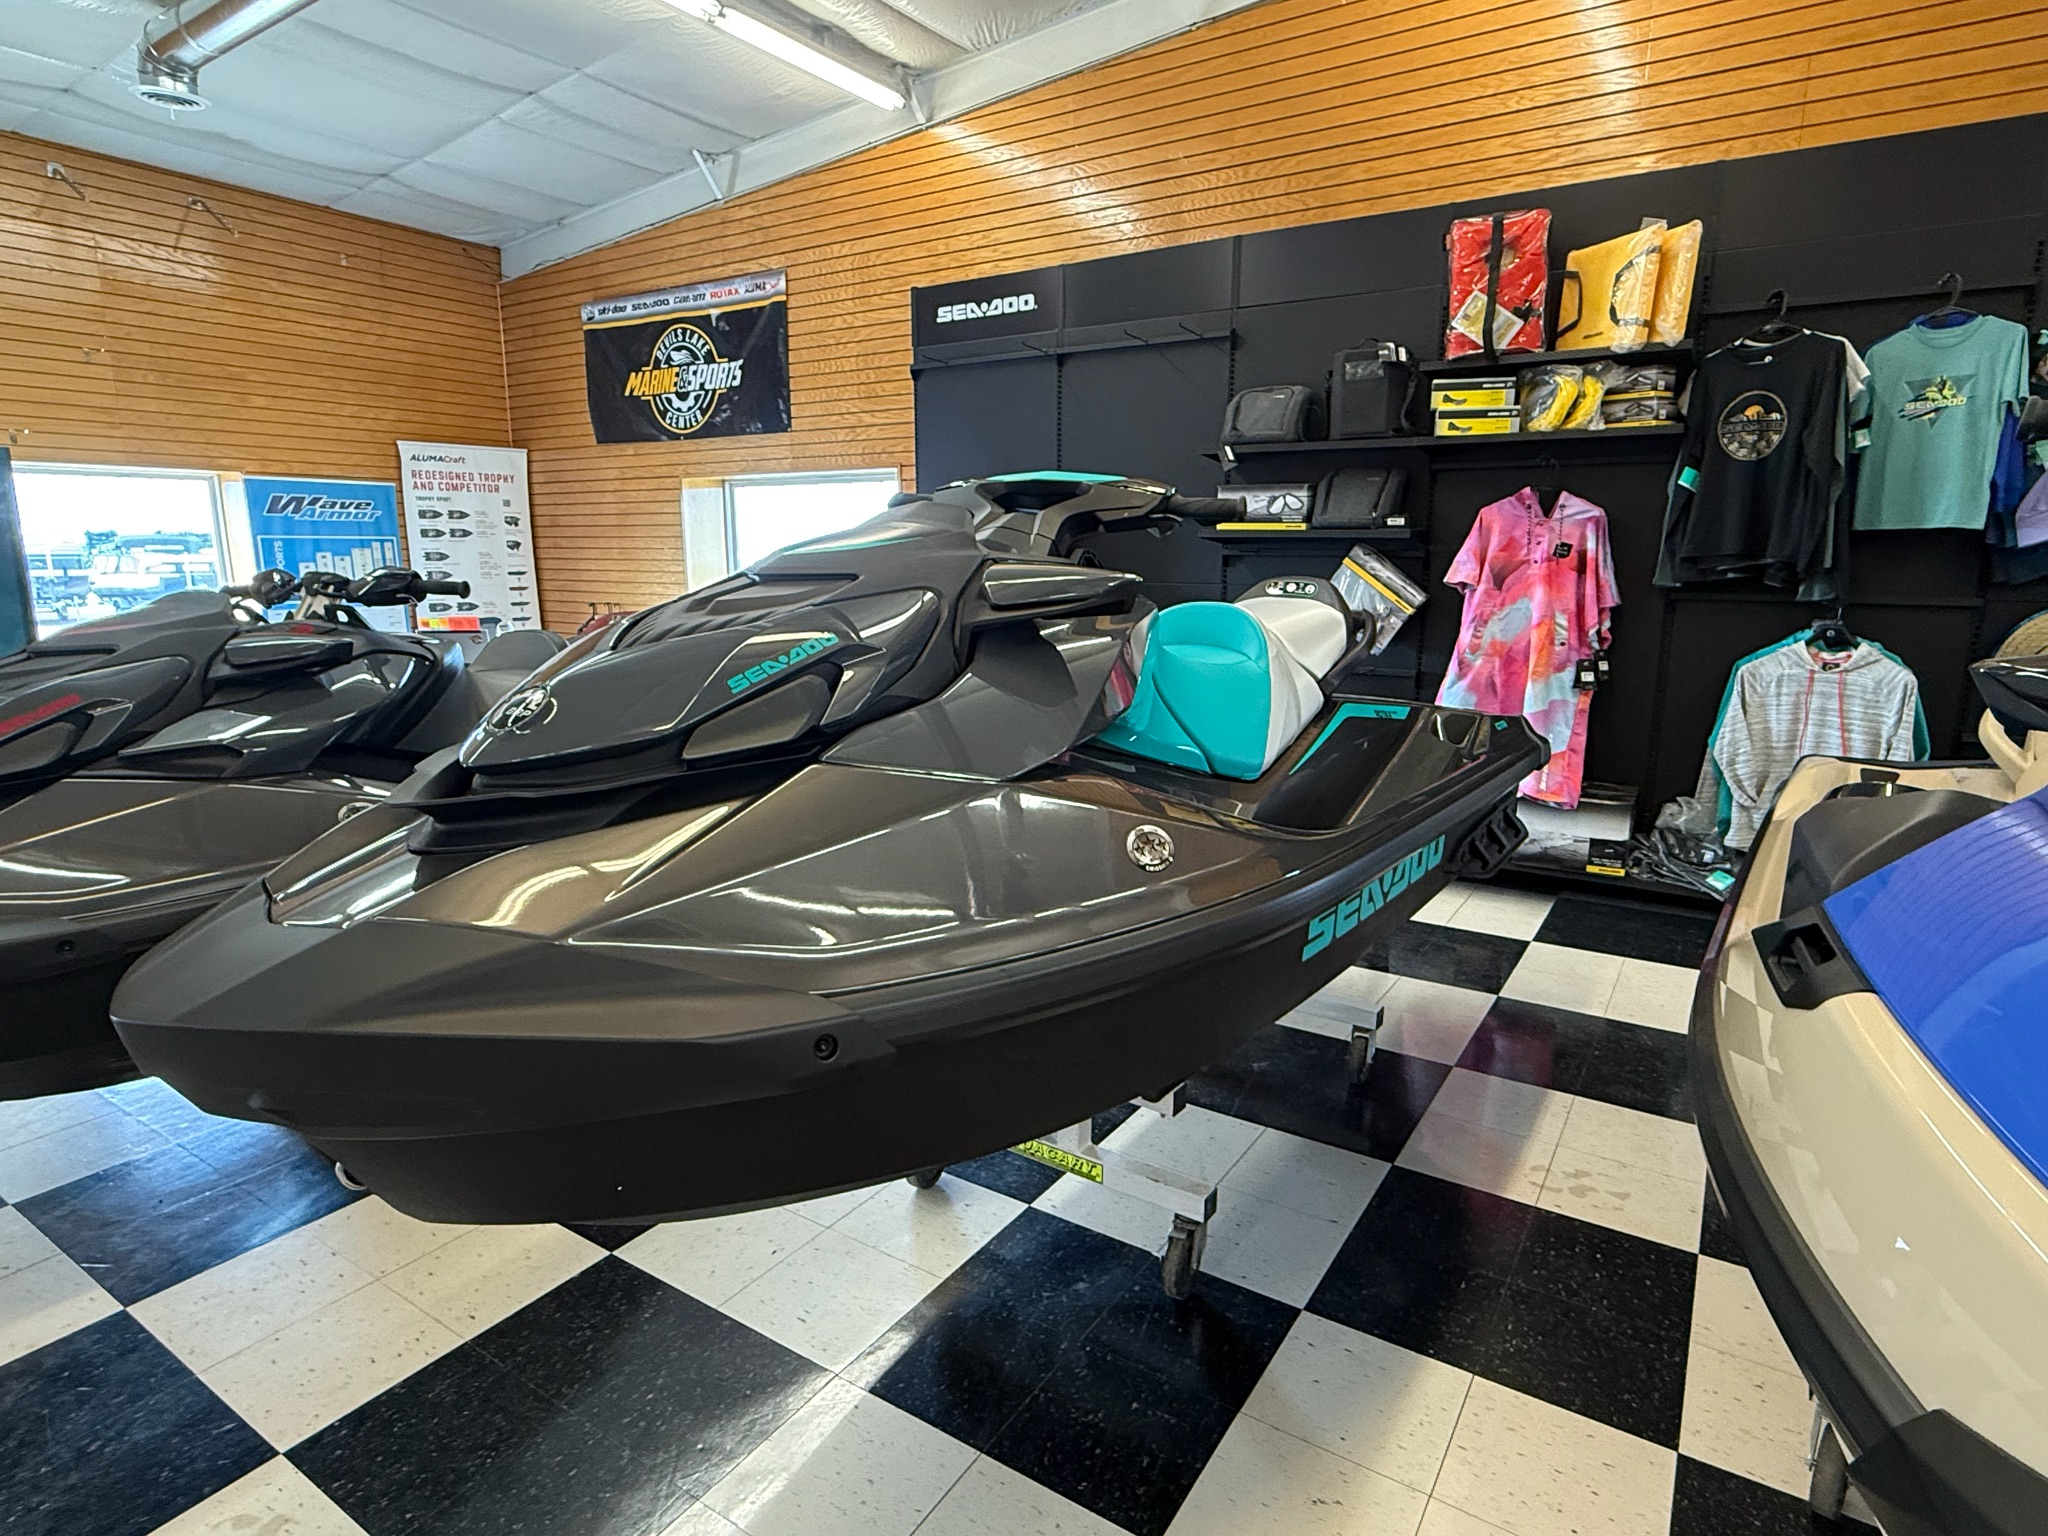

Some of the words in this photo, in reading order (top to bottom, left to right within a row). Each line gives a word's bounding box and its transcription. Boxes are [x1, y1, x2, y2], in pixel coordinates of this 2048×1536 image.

[710, 288, 740, 300] ROTAX
[656, 328, 683, 360] DEVILS
[685, 329, 711, 356] LAKE
[665, 409, 703, 428] CENTER
[409, 454, 466, 464] ALUMACraft
[411, 469, 475, 482] REDESIGNED
[477, 472, 515, 484] TROPHY
[412, 481, 434, 491] AND
[438, 481, 500, 493] COMPETITOR
[263, 493, 374, 517] Wave
[295, 507, 382, 522] Armor
